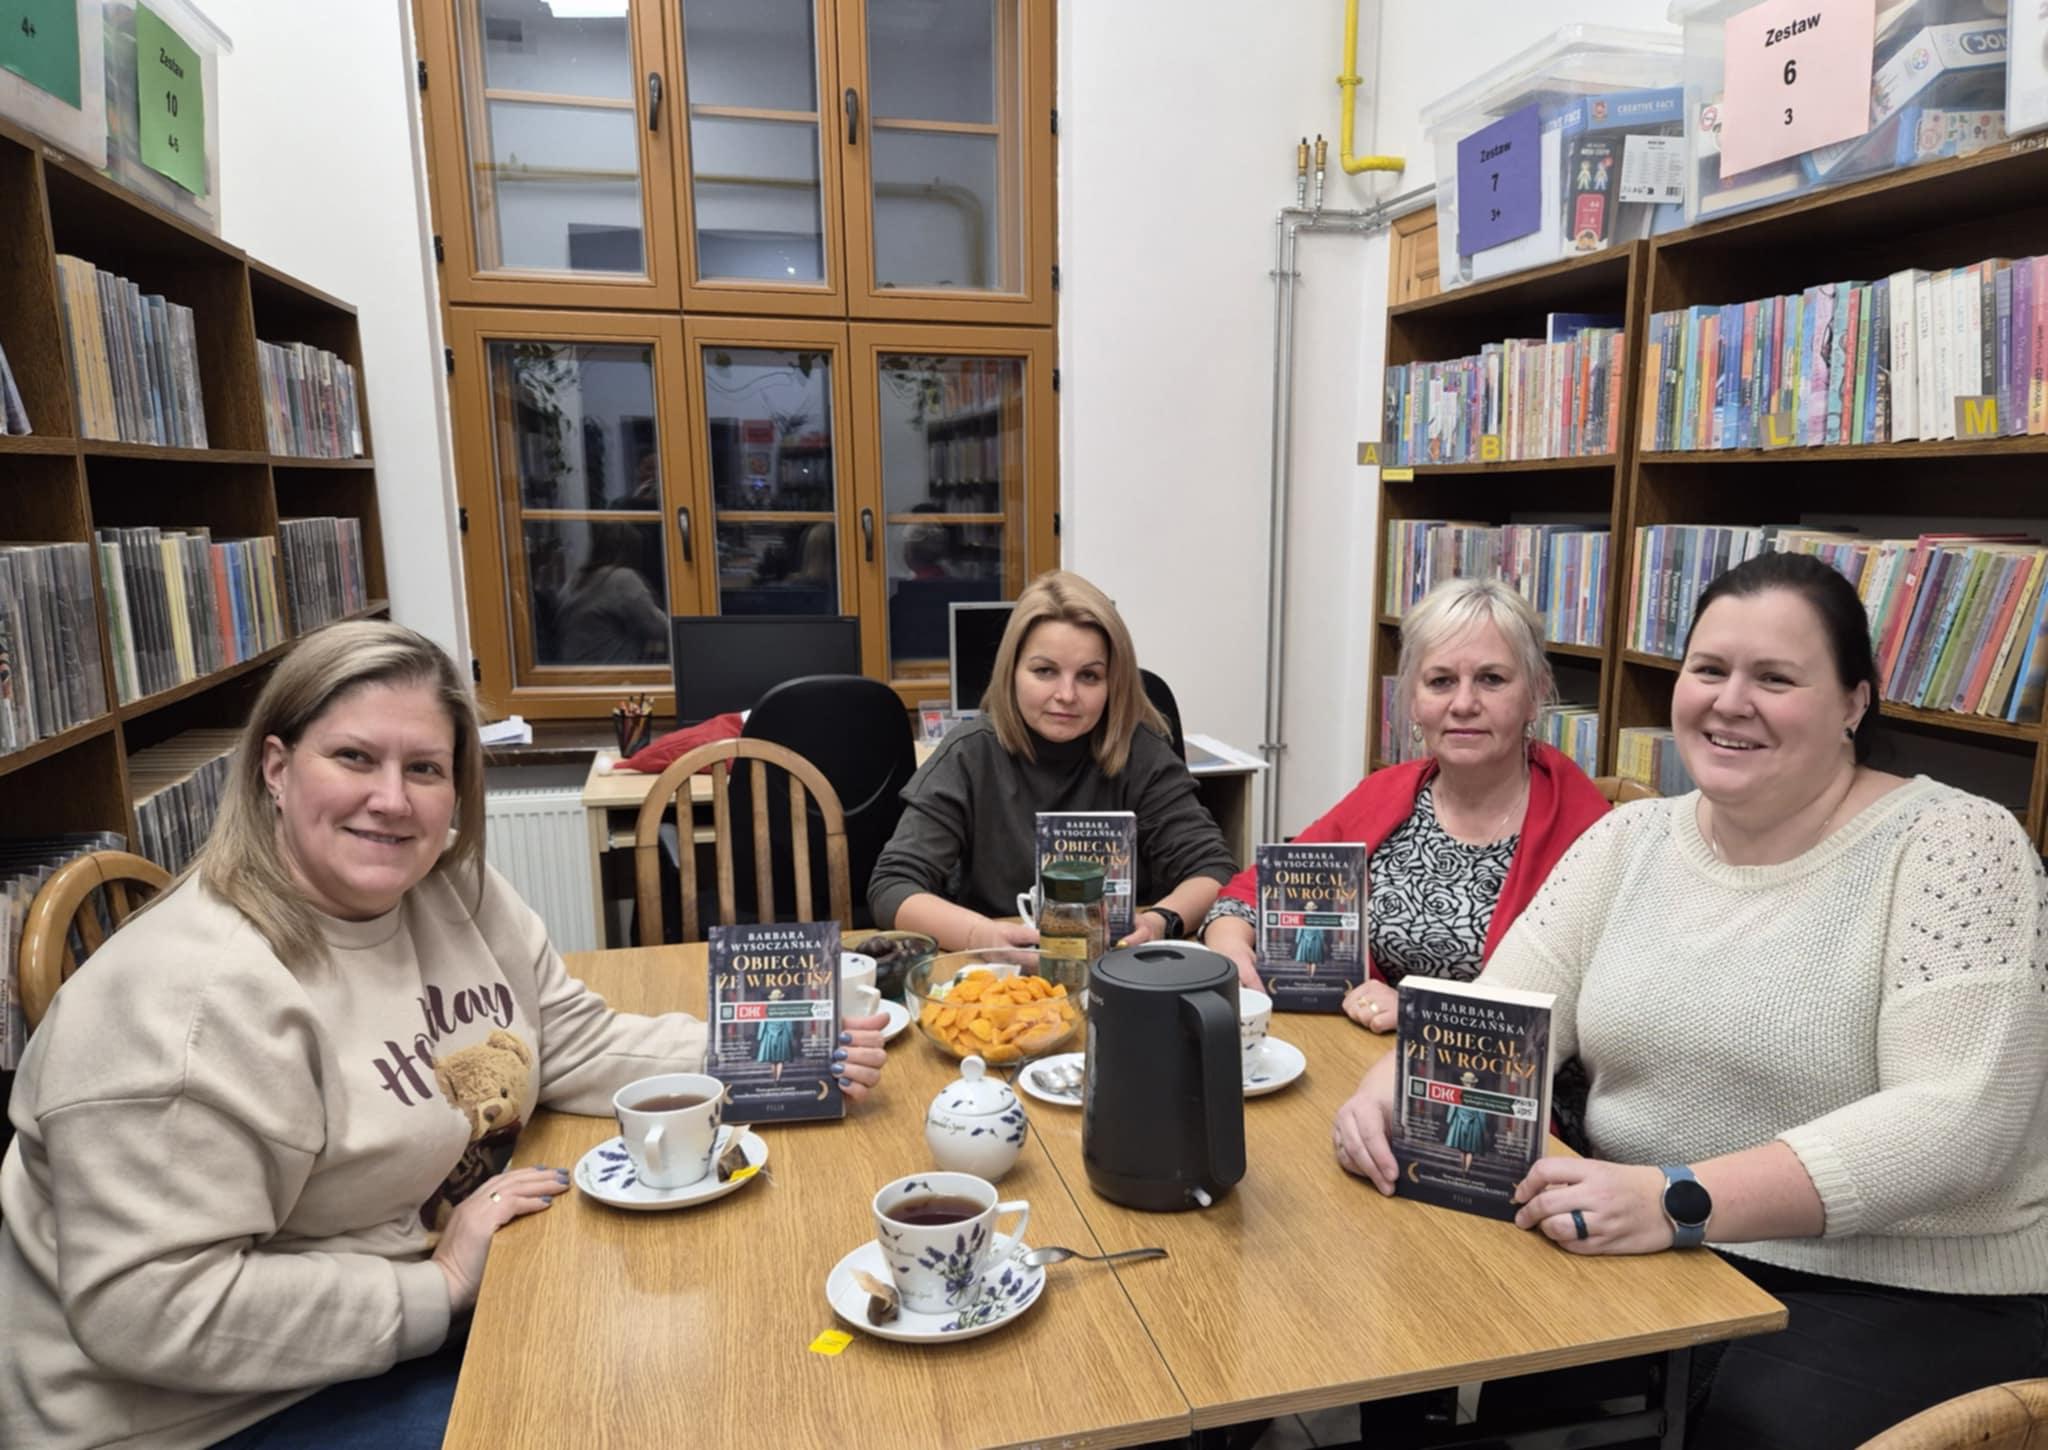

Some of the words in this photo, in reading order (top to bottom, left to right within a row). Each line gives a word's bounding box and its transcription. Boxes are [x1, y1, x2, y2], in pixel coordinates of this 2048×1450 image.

[1765, 13, 1822, 47] Zestaw
[160, 47, 184, 79] Zestaw
[1783, 59, 1797, 86] 6
[166, 91, 178, 117] 10
[1655, 99, 1675, 110] FACE
[1783, 108, 1794, 126] 3
[1480, 141, 1512, 163] Zestaw
[1491, 173, 1499, 192] 7
[1490, 208, 1501, 222] 3+
[1964, 399, 1998, 435] M
[1769, 415, 1789, 446] L
[1363, 444, 1379, 464] A
[1481, 436, 1500, 460] B
[1066, 821, 1109, 829] BARBARA
[1273, 859, 1349, 869] WYSOCZAŃSKA
[1287, 852, 1335, 860] BARBARA
[731, 940, 822, 952] WYSOCZAŃSKA
[748, 931, 805, 941] BARBARA
[747, 970, 833, 988] WRÓCISZ
[1440, 1001, 1505, 1021] BARBARA
[1421, 1009, 1525, 1036] WYSOCZAŃSKA
[1437, 1048, 1537, 1080] WRÓCISZ
